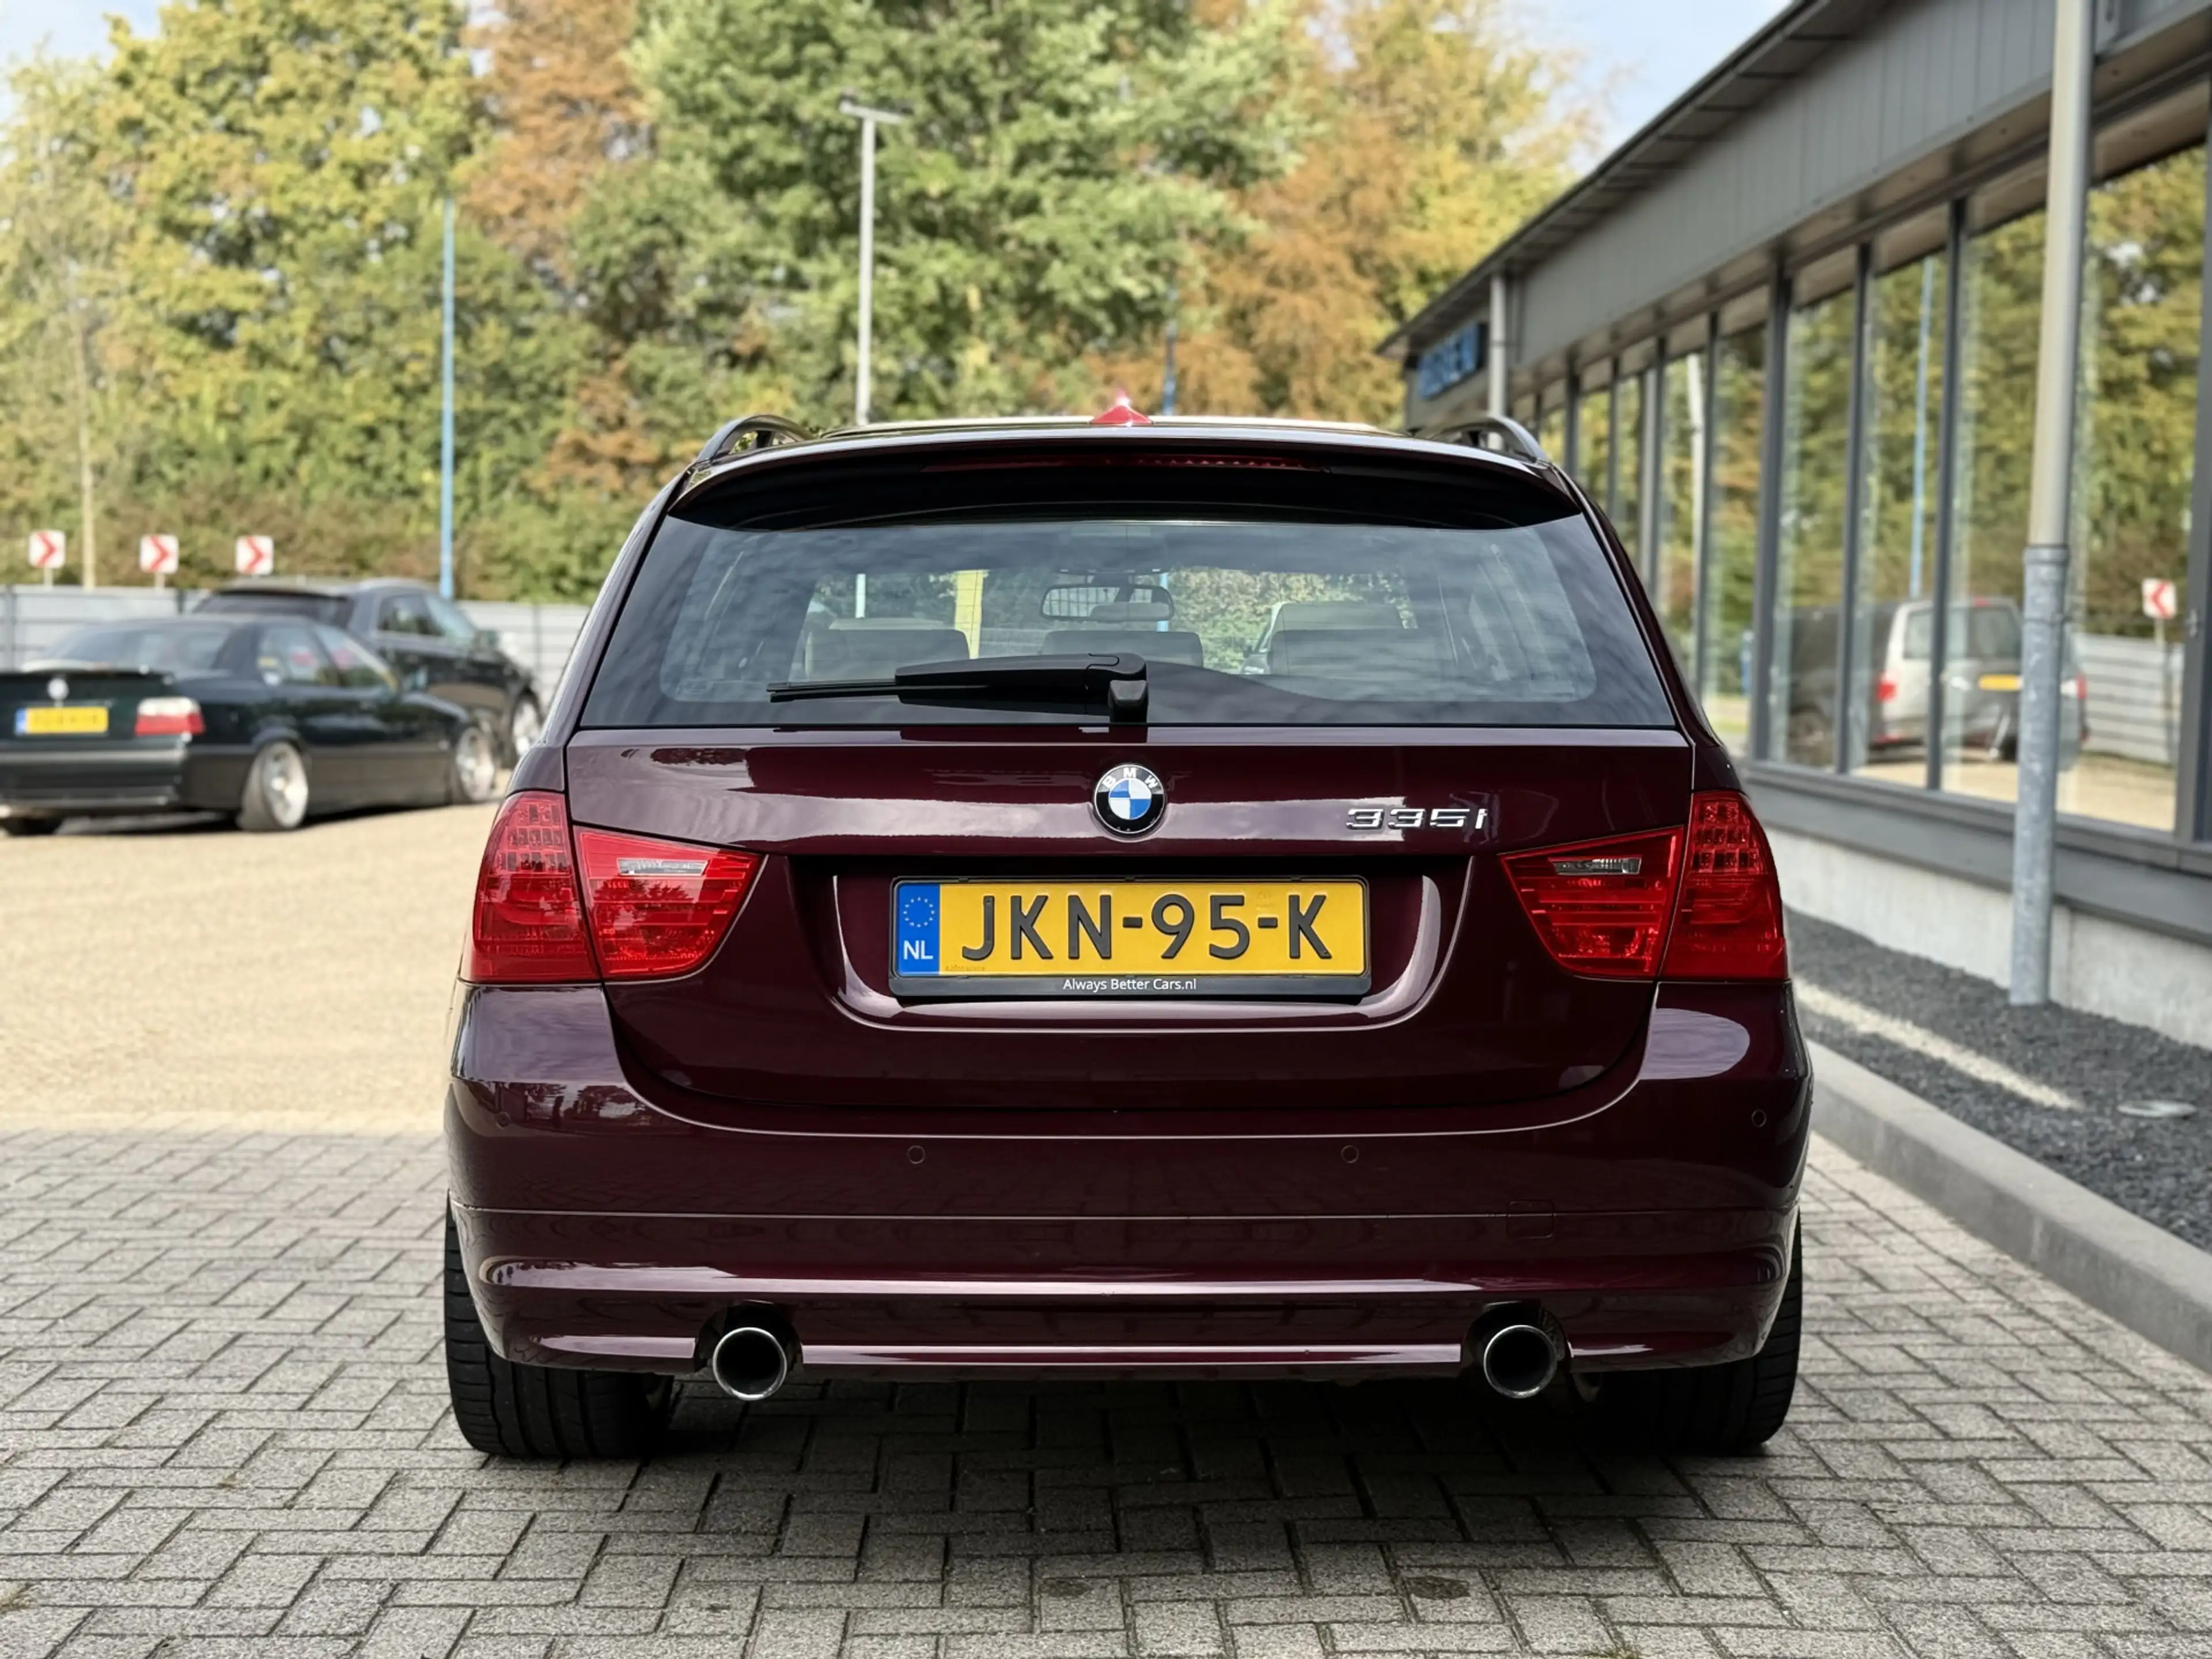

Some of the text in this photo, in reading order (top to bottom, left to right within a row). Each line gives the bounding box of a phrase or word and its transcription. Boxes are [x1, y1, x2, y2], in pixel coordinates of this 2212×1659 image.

[1101, 767, 1158, 789] BMW
[1346, 808, 1488, 830] 335i
[961, 895, 1333, 961] JKN-95-K
[903, 940, 934, 960] NL
[1063, 978, 1196, 993] Always Better Cars.nl
